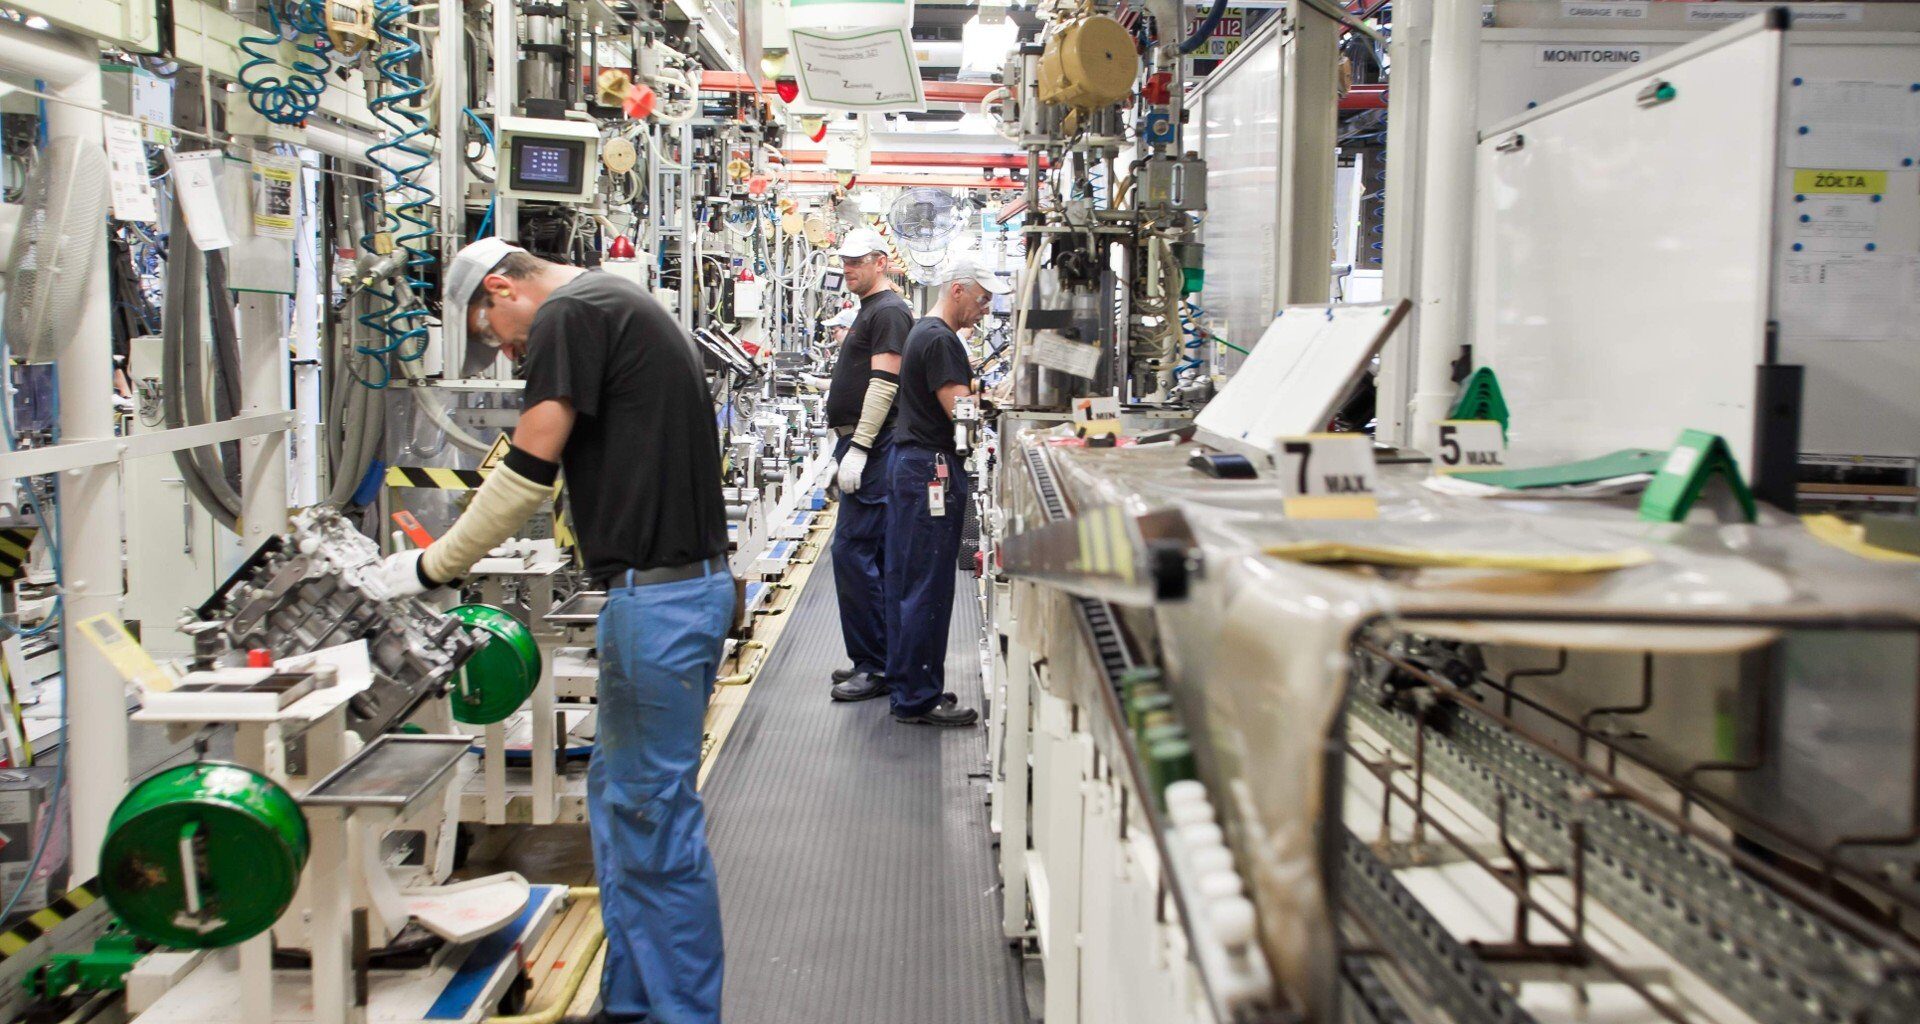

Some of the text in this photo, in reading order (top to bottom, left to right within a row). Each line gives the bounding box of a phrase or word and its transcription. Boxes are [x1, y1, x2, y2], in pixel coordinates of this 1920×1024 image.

[1569, 8, 1642, 17] CABBAGE FIELD
[1543, 50, 1641, 63] MONITORING
[1814, 172, 1866, 188] ŻÓŁTA
[1439, 425, 1503, 466] 5 MAX.
[1283, 441, 1373, 494] 7 MAX.
